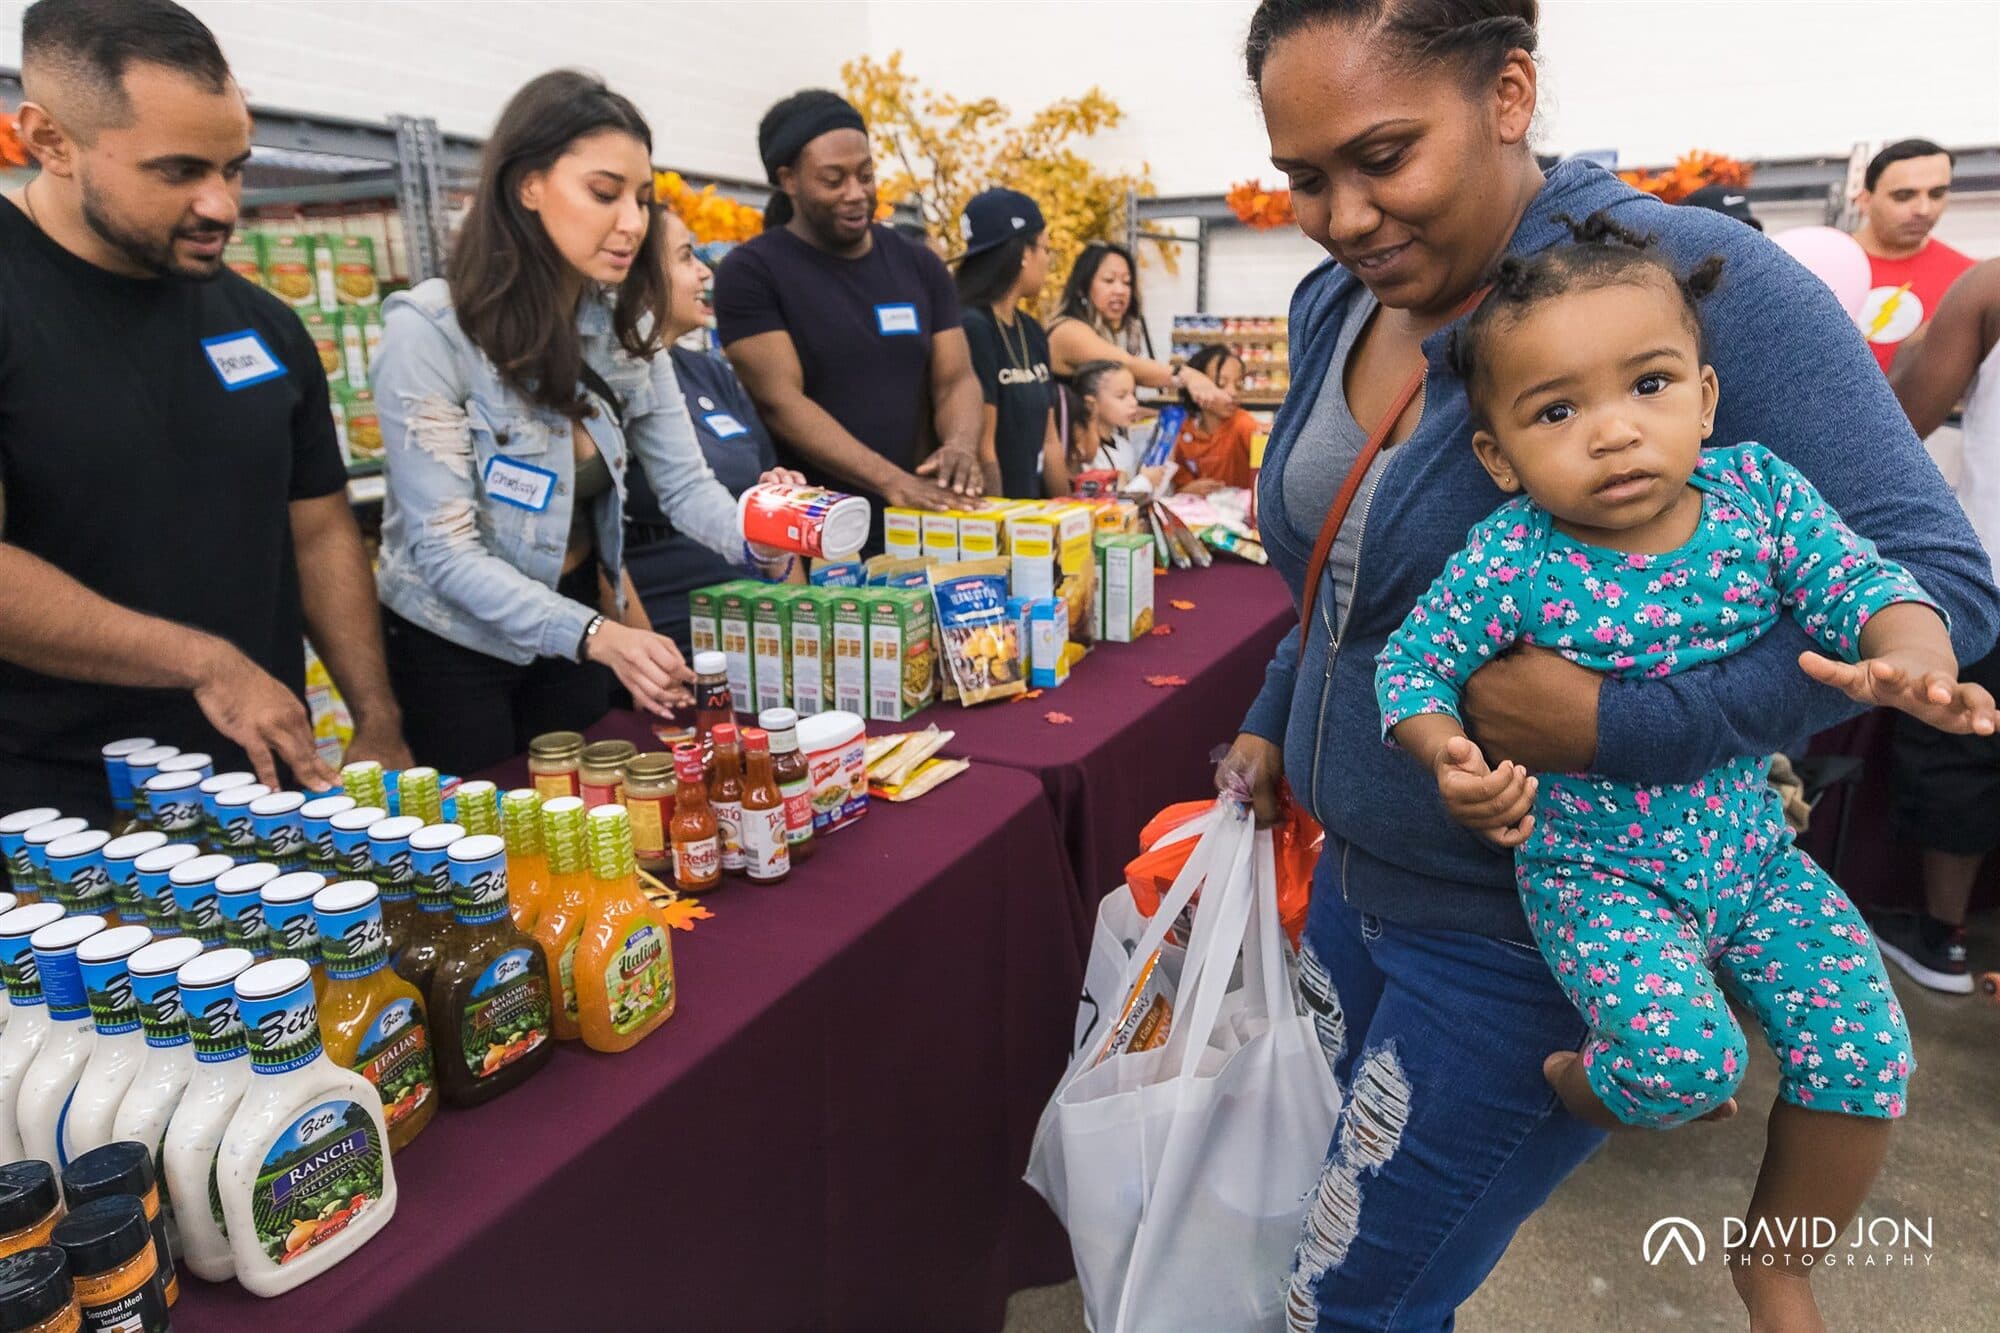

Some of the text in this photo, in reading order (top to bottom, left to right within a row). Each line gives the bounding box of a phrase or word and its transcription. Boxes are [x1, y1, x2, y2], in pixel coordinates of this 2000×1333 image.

[470, 870, 508, 902] Zit
[343, 917, 385, 957] Zit
[496, 959, 521, 980] Zito
[618, 936, 662, 973] Italian
[484, 988, 536, 1020] VINAIGRETTE
[491, 982, 529, 1008] BALSAMIC
[100, 1023, 139, 1034] PREMIUM
[257, 1002, 318, 1048] Zito
[148, 1037, 184, 1048] PREMIUM
[199, 1051, 236, 1063] PREMIUM
[374, 1032, 418, 1074] ITALIAN
[253, 1053, 315, 1074] PREMIUM SALAD
[300, 1112, 335, 1143] Zito
[288, 1138, 355, 1186] RANCH
[301, 1161, 356, 1197] DRESSING
[86, 1292, 144, 1321] Seasoned Meat
[100, 1310, 133, 1327] Tenderizer
